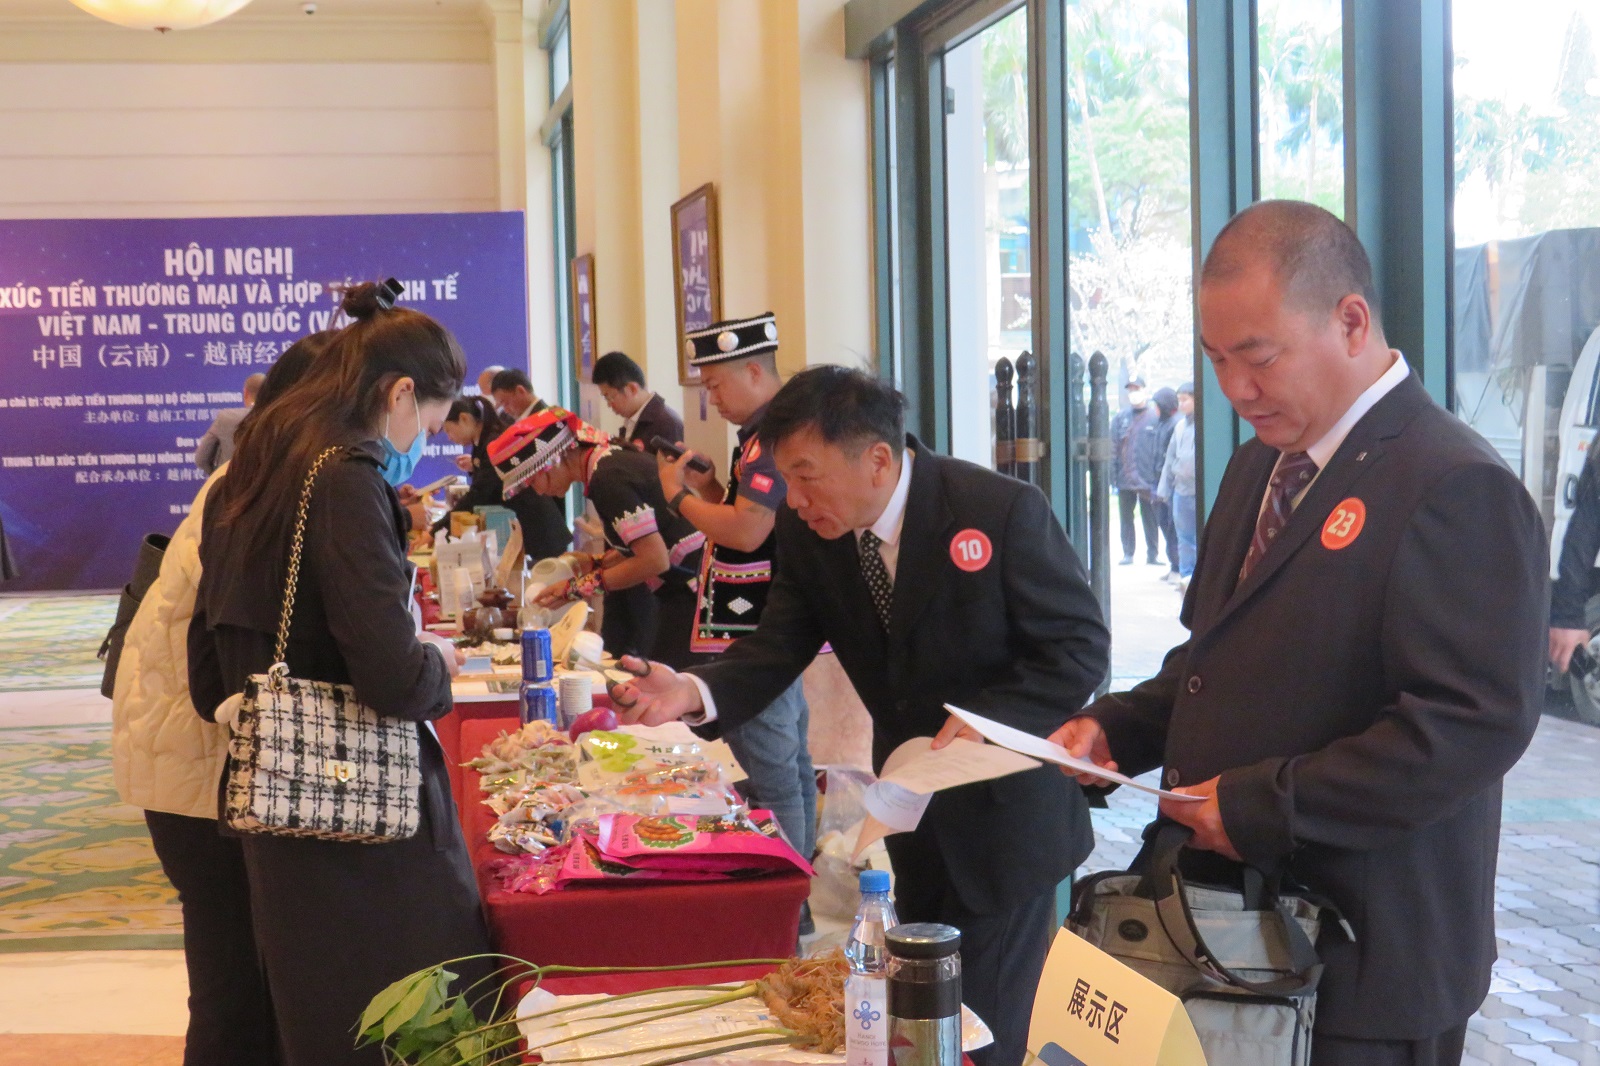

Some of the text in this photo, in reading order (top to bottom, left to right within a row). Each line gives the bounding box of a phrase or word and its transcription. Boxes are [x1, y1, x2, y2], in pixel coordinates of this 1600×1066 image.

[164, 242, 293, 282] HỘI NGHỊ
[0, 281, 42, 309] XÚC
[48, 278, 97, 307] TIẾN
[103, 282, 190, 307] THƯƠNG
[197, 283, 238, 309] MẠI
[244, 278, 273, 304] VÀ
[278, 279, 323, 308] HỢP
[432, 271, 460, 300] TẾ
[38, 310, 86, 341] VIỆT
[92, 314, 141, 336] NAM
[163, 312, 235, 335] TRUNG
[242, 304, 301, 336] QUỐC
[64, 393, 84, 407] XÚC
[1326, 508, 1357, 538] 23
[957, 538, 983, 562] 10
[1066, 977, 1128, 1045] 展示区
